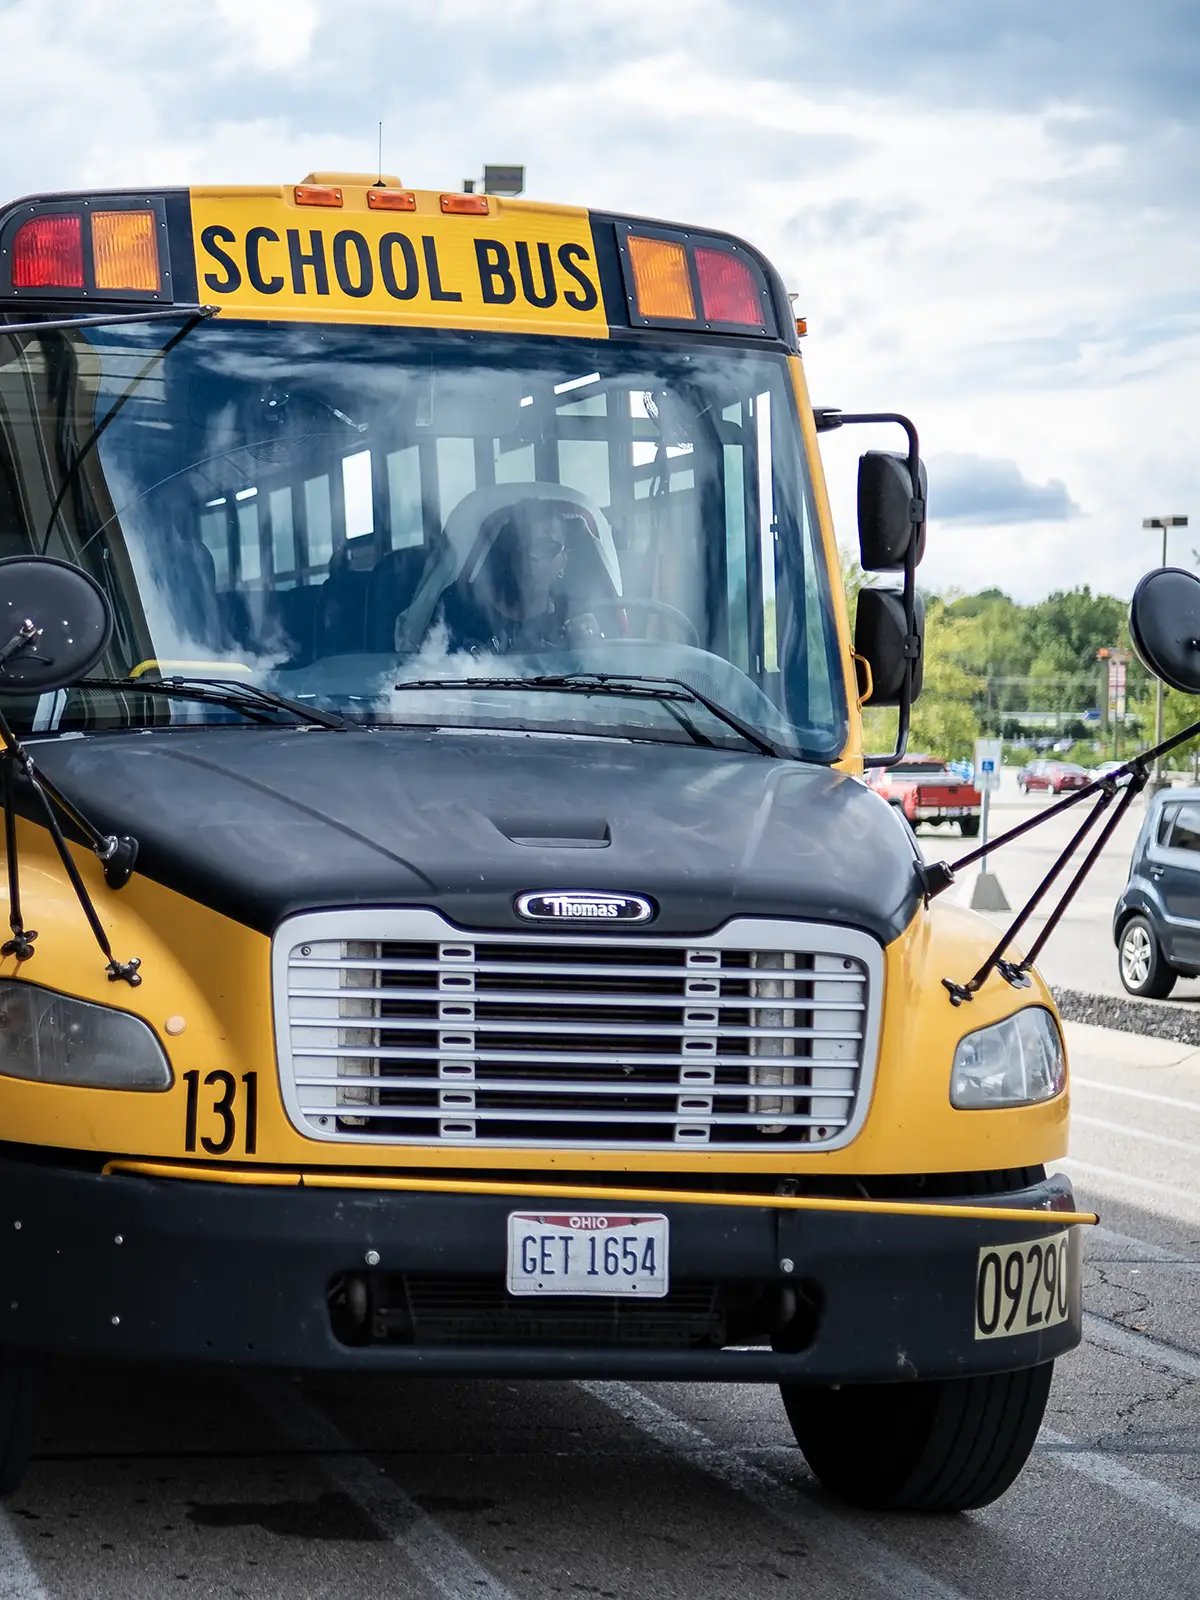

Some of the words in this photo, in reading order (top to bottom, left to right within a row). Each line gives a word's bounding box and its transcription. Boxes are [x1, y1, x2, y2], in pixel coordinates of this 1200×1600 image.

[201, 225, 463, 302] SCHOOL
[473, 238, 598, 311] BUS
[542, 896, 627, 918] Thomas
[182, 1069, 258, 1155] 131
[569, 1216, 609, 1229] OHIO
[522, 1235, 575, 1275] GET
[587, 1236, 657, 1276] 1654
[977, 1237, 1069, 1335] 09290
